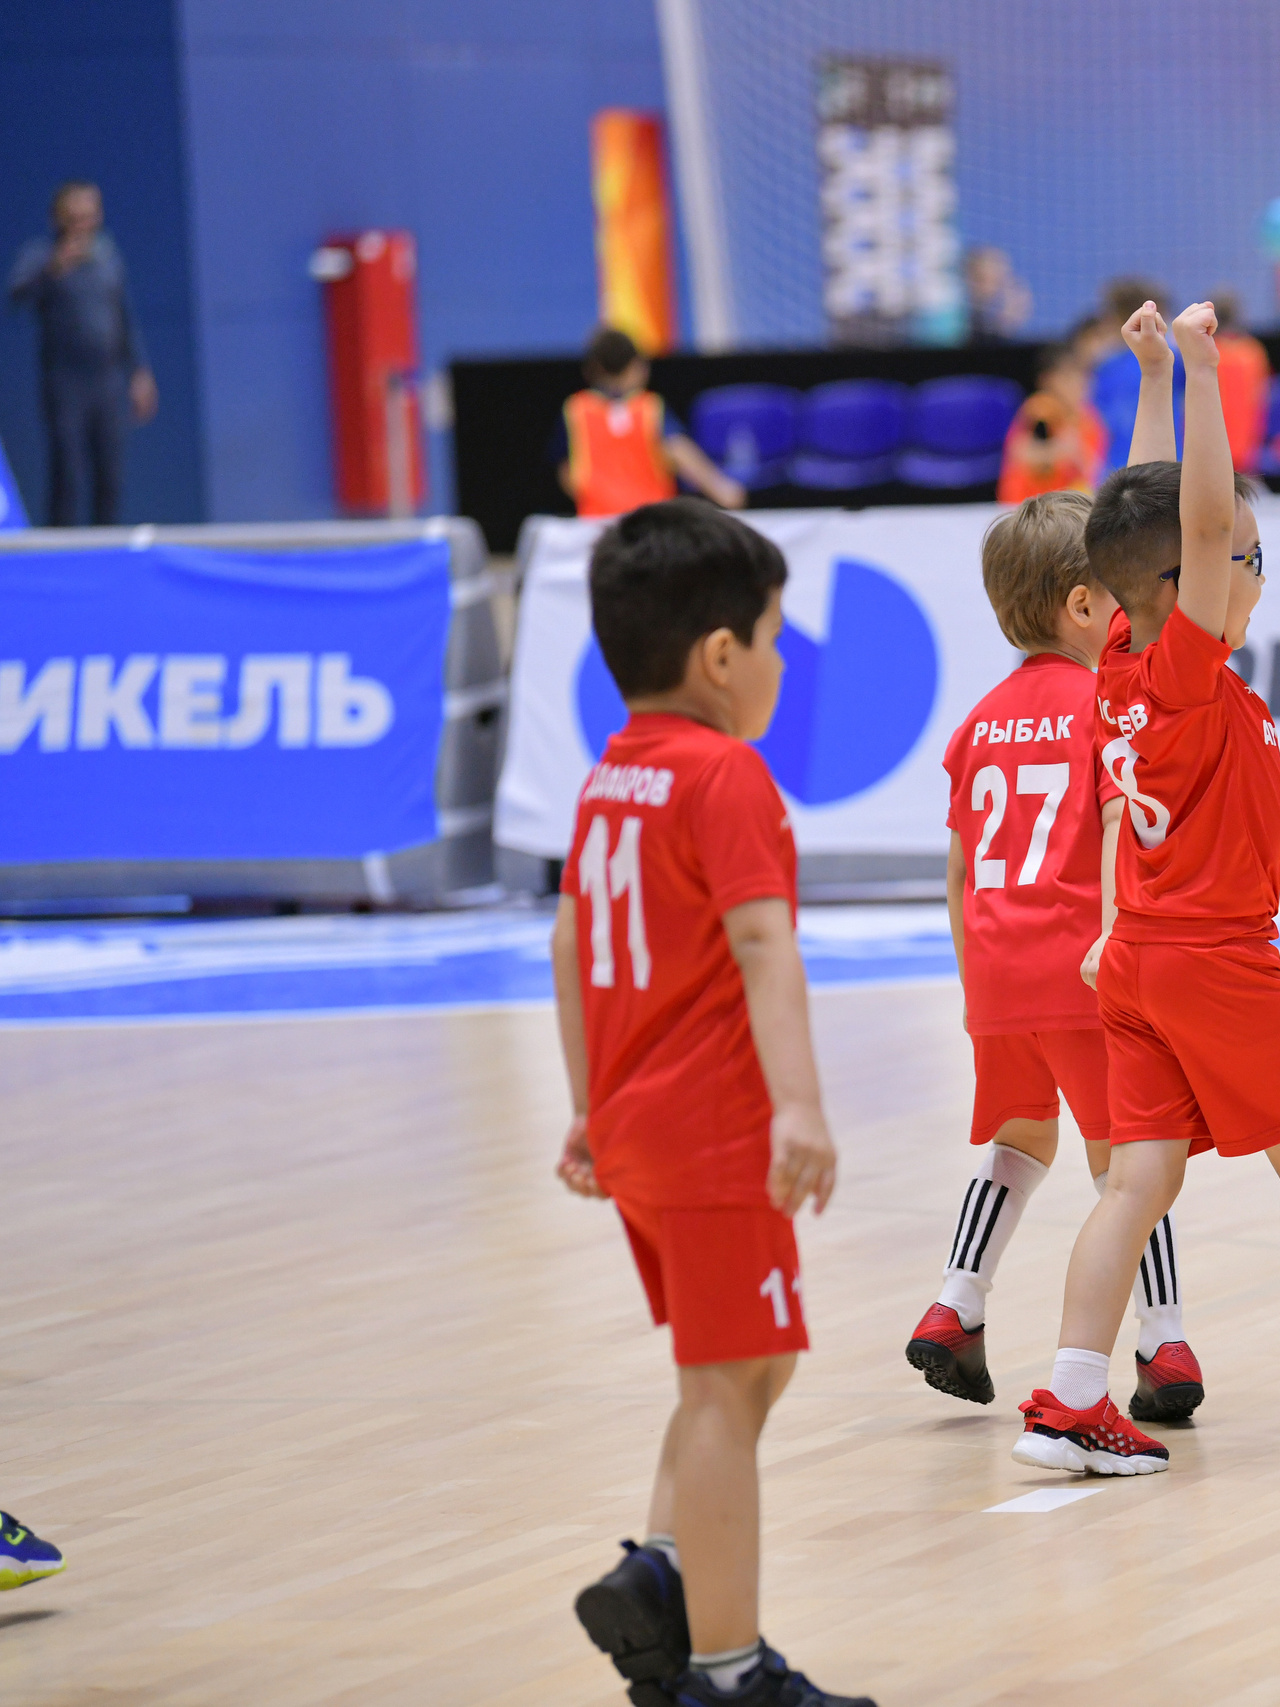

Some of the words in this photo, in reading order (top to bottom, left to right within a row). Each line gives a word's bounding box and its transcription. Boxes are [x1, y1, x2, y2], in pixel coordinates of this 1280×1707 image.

[972, 714, 1074, 747] РЫБАК
[971, 762, 1070, 896] 27
[1102, 737, 1170, 850] 8
[578, 814, 652, 992] 11
